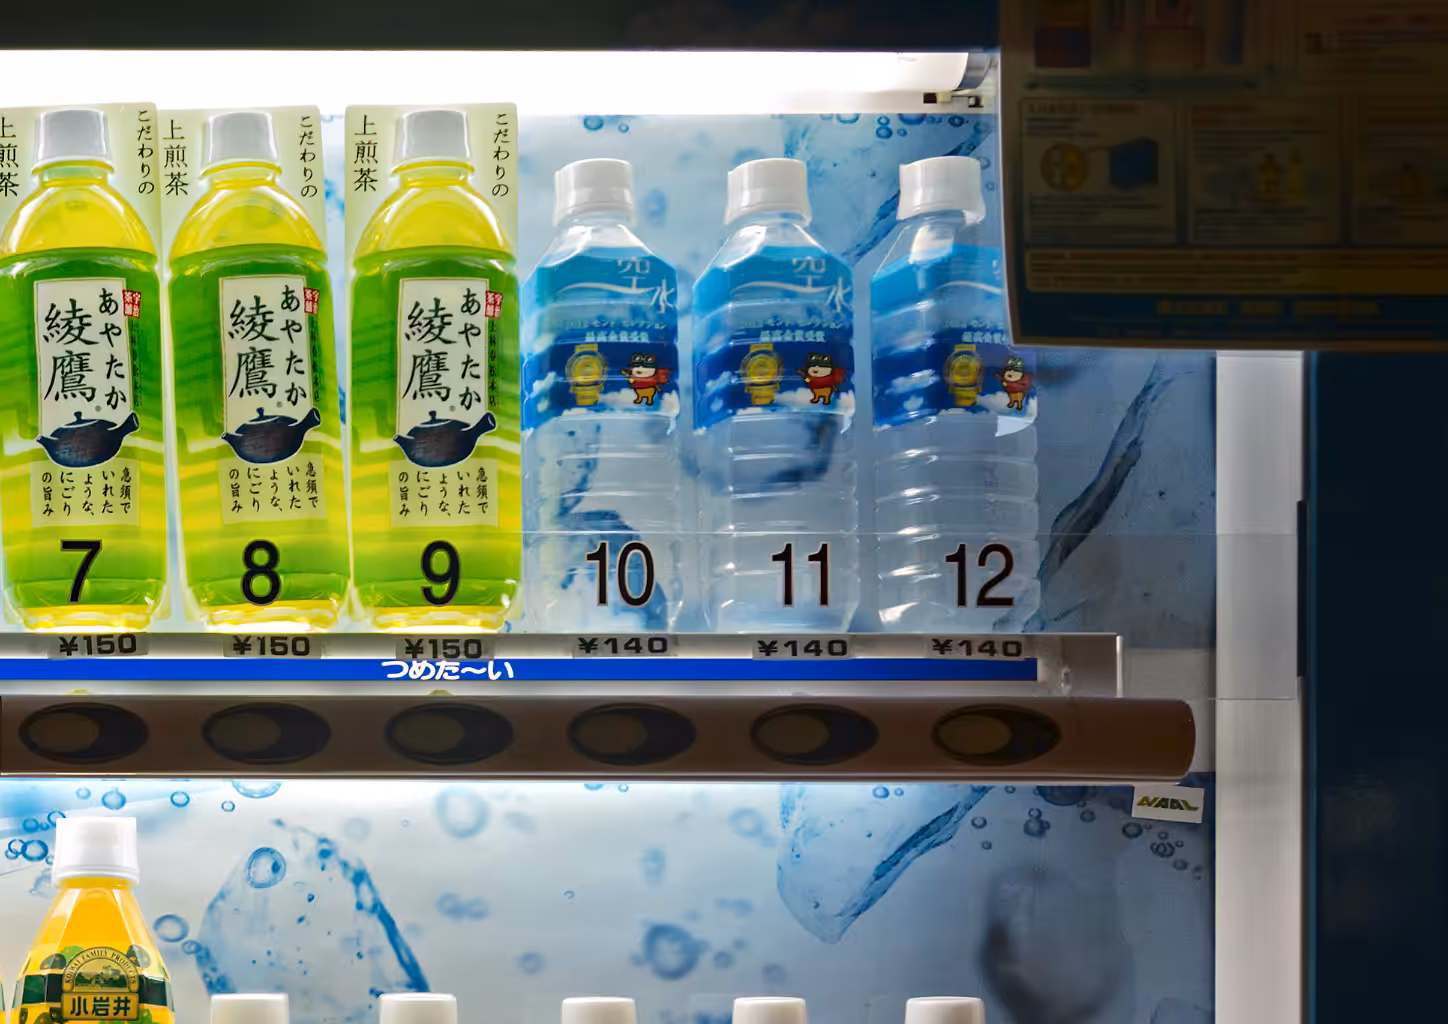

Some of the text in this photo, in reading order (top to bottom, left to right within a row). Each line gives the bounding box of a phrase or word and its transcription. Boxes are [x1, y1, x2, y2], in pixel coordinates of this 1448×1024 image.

[137, 108, 156, 196] こだわりの
[163, 118, 190, 197] 上煎茶
[299, 114, 319, 198] こだわりの
[353, 113, 380, 194] 上煎茶
[491, 111, 510, 198] こだわりの
[43, 298, 99, 402] 綾鷹
[99, 288, 127, 410] あやたか
[228, 295, 280, 398] 綾鷹
[280, 284, 307, 406] あやたか
[402, 297, 457, 402] 綾鷹
[458, 288, 482, 411] あやたか
[59, 540, 103, 604] 7
[240, 540, 281, 606] 8
[420, 540, 461, 606] 9
[586, 542, 655, 608] 10
[772, 542, 829, 608] 11
[945, 543, 1014, 608] 12
[60, 634, 138, 656] ¥150
[233, 635, 310, 656] ¥150
[405, 638, 483, 659] ¥150
[579, 637, 667, 655] ¥140
[758, 639, 848, 657] ¥140
[933, 638, 1023, 657] ¥140
[70, 996, 131, 1016] 小岩井
